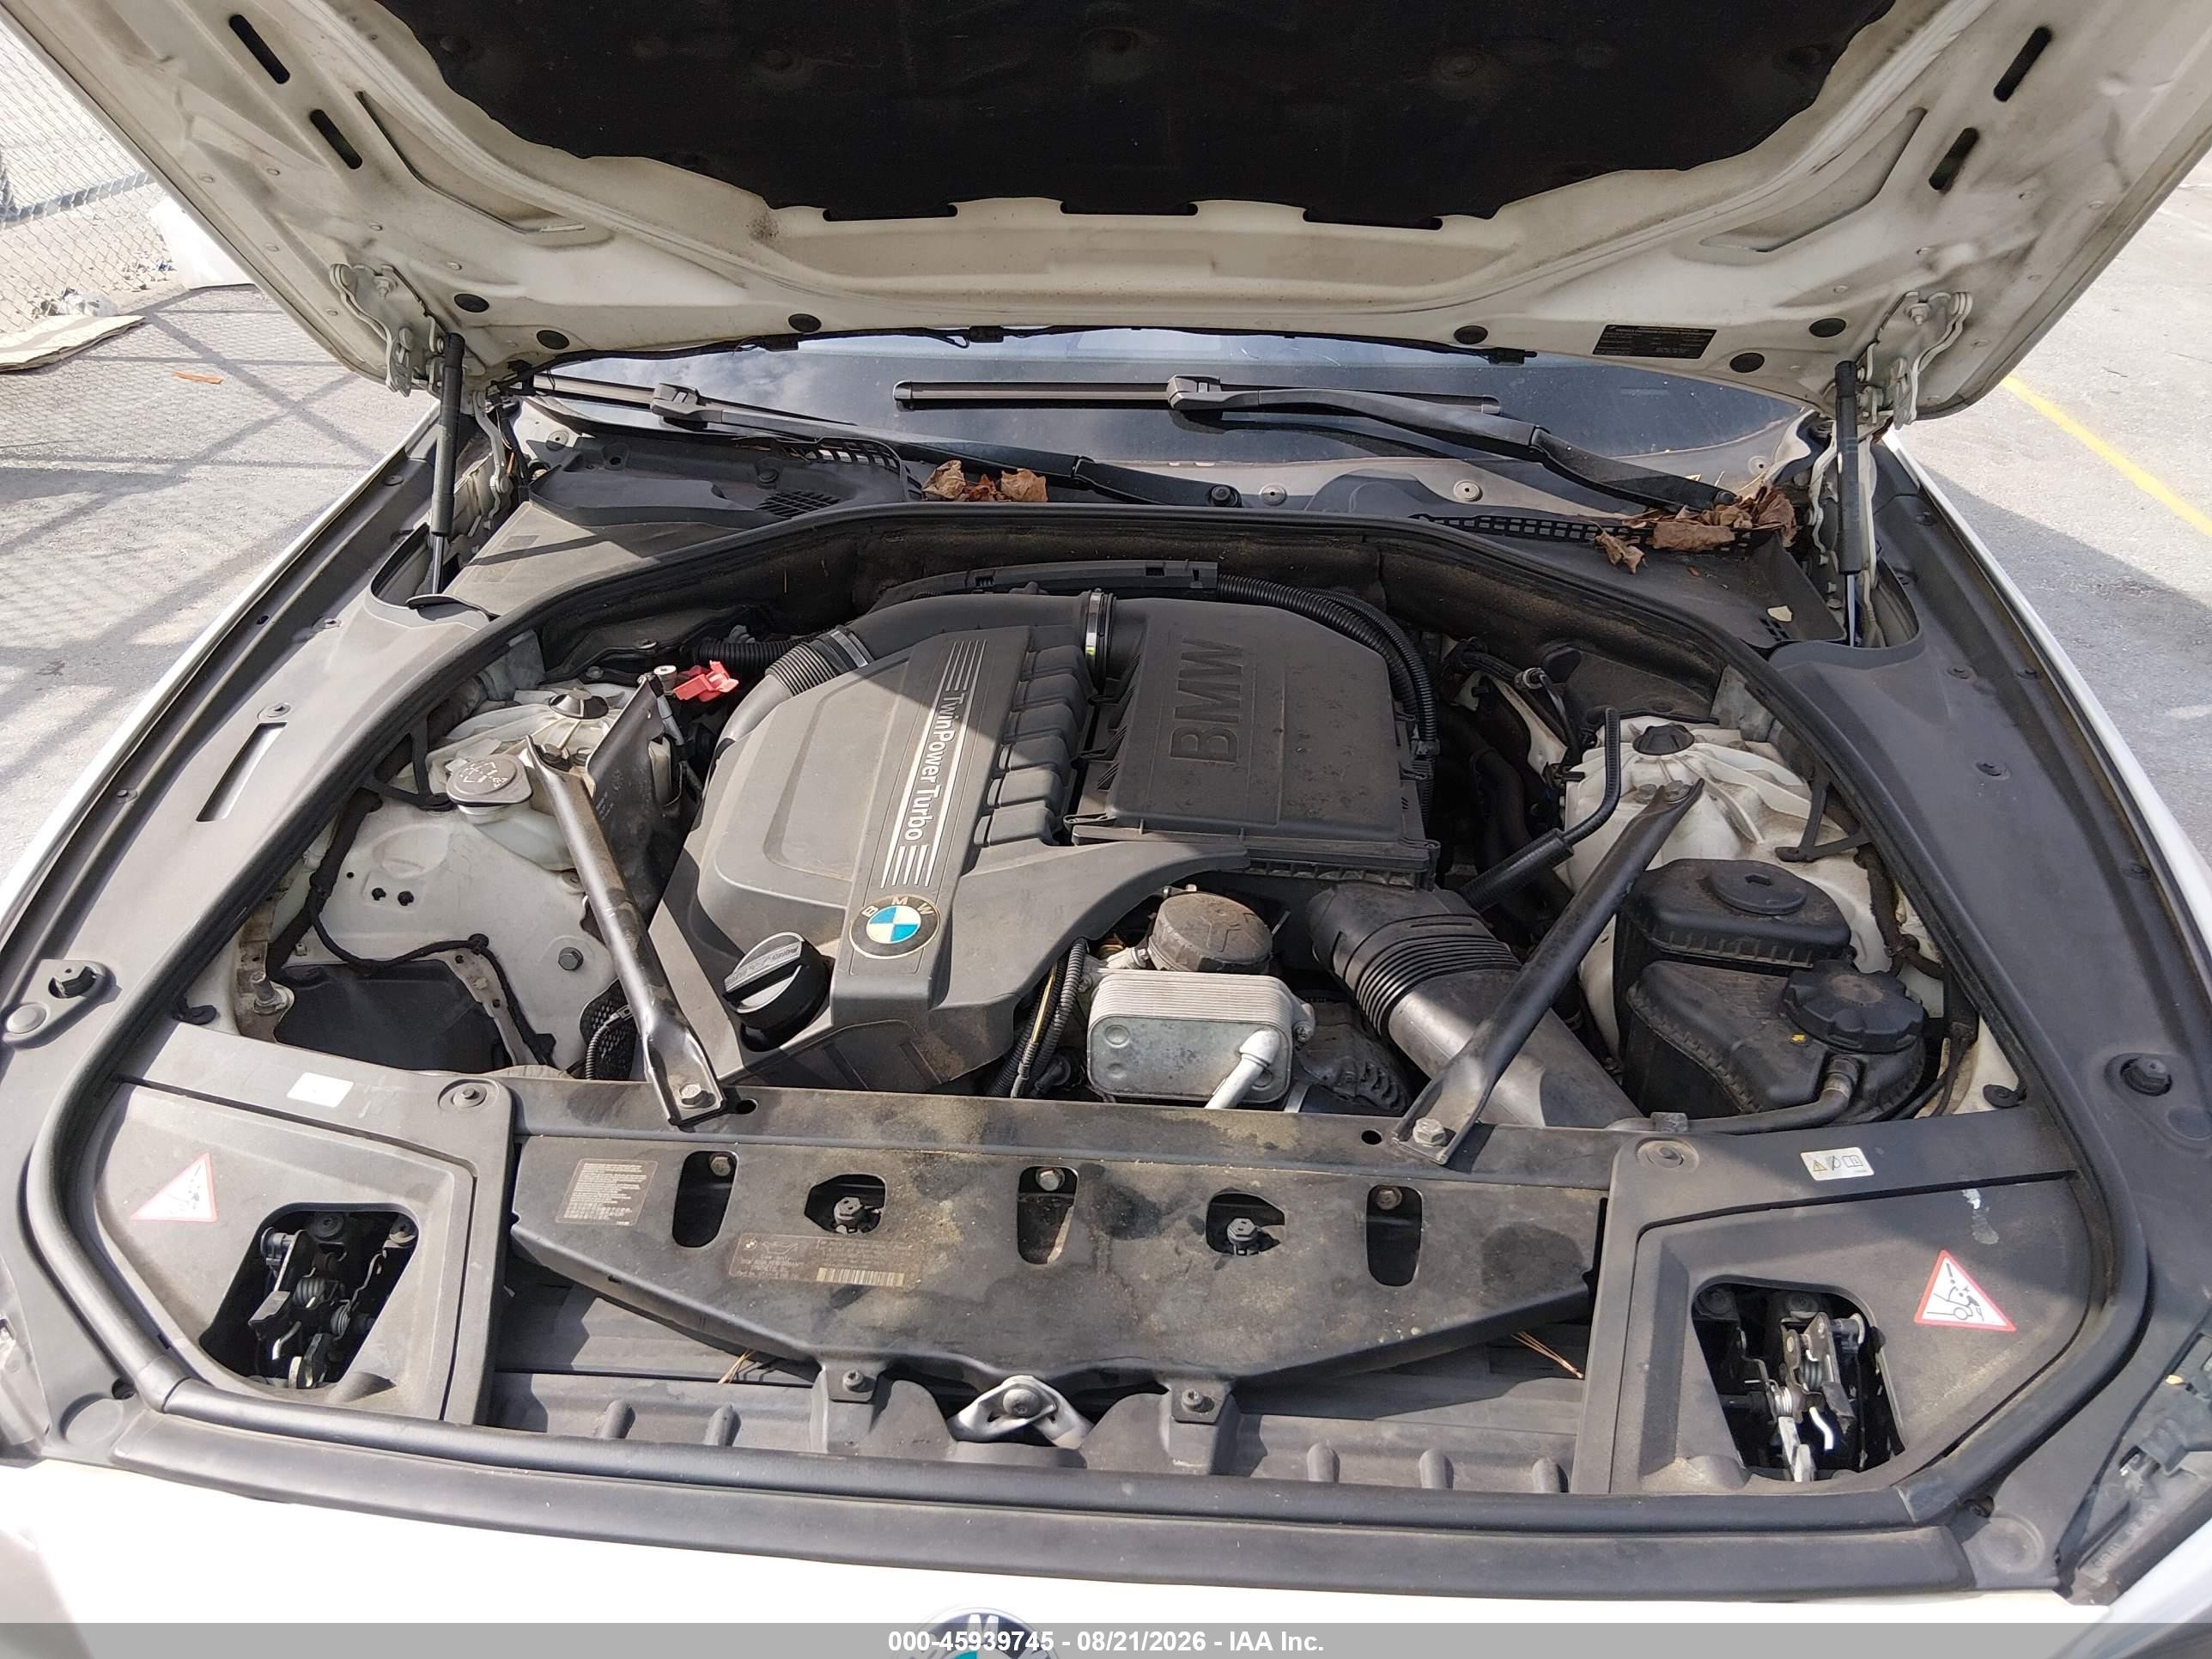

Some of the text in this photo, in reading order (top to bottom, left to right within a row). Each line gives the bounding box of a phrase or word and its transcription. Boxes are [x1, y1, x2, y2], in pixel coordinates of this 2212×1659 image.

[1169, 638, 1244, 765] BMW
[904, 692, 966, 841] TwinPower Turbo
[861, 896, 936, 918] BMW
